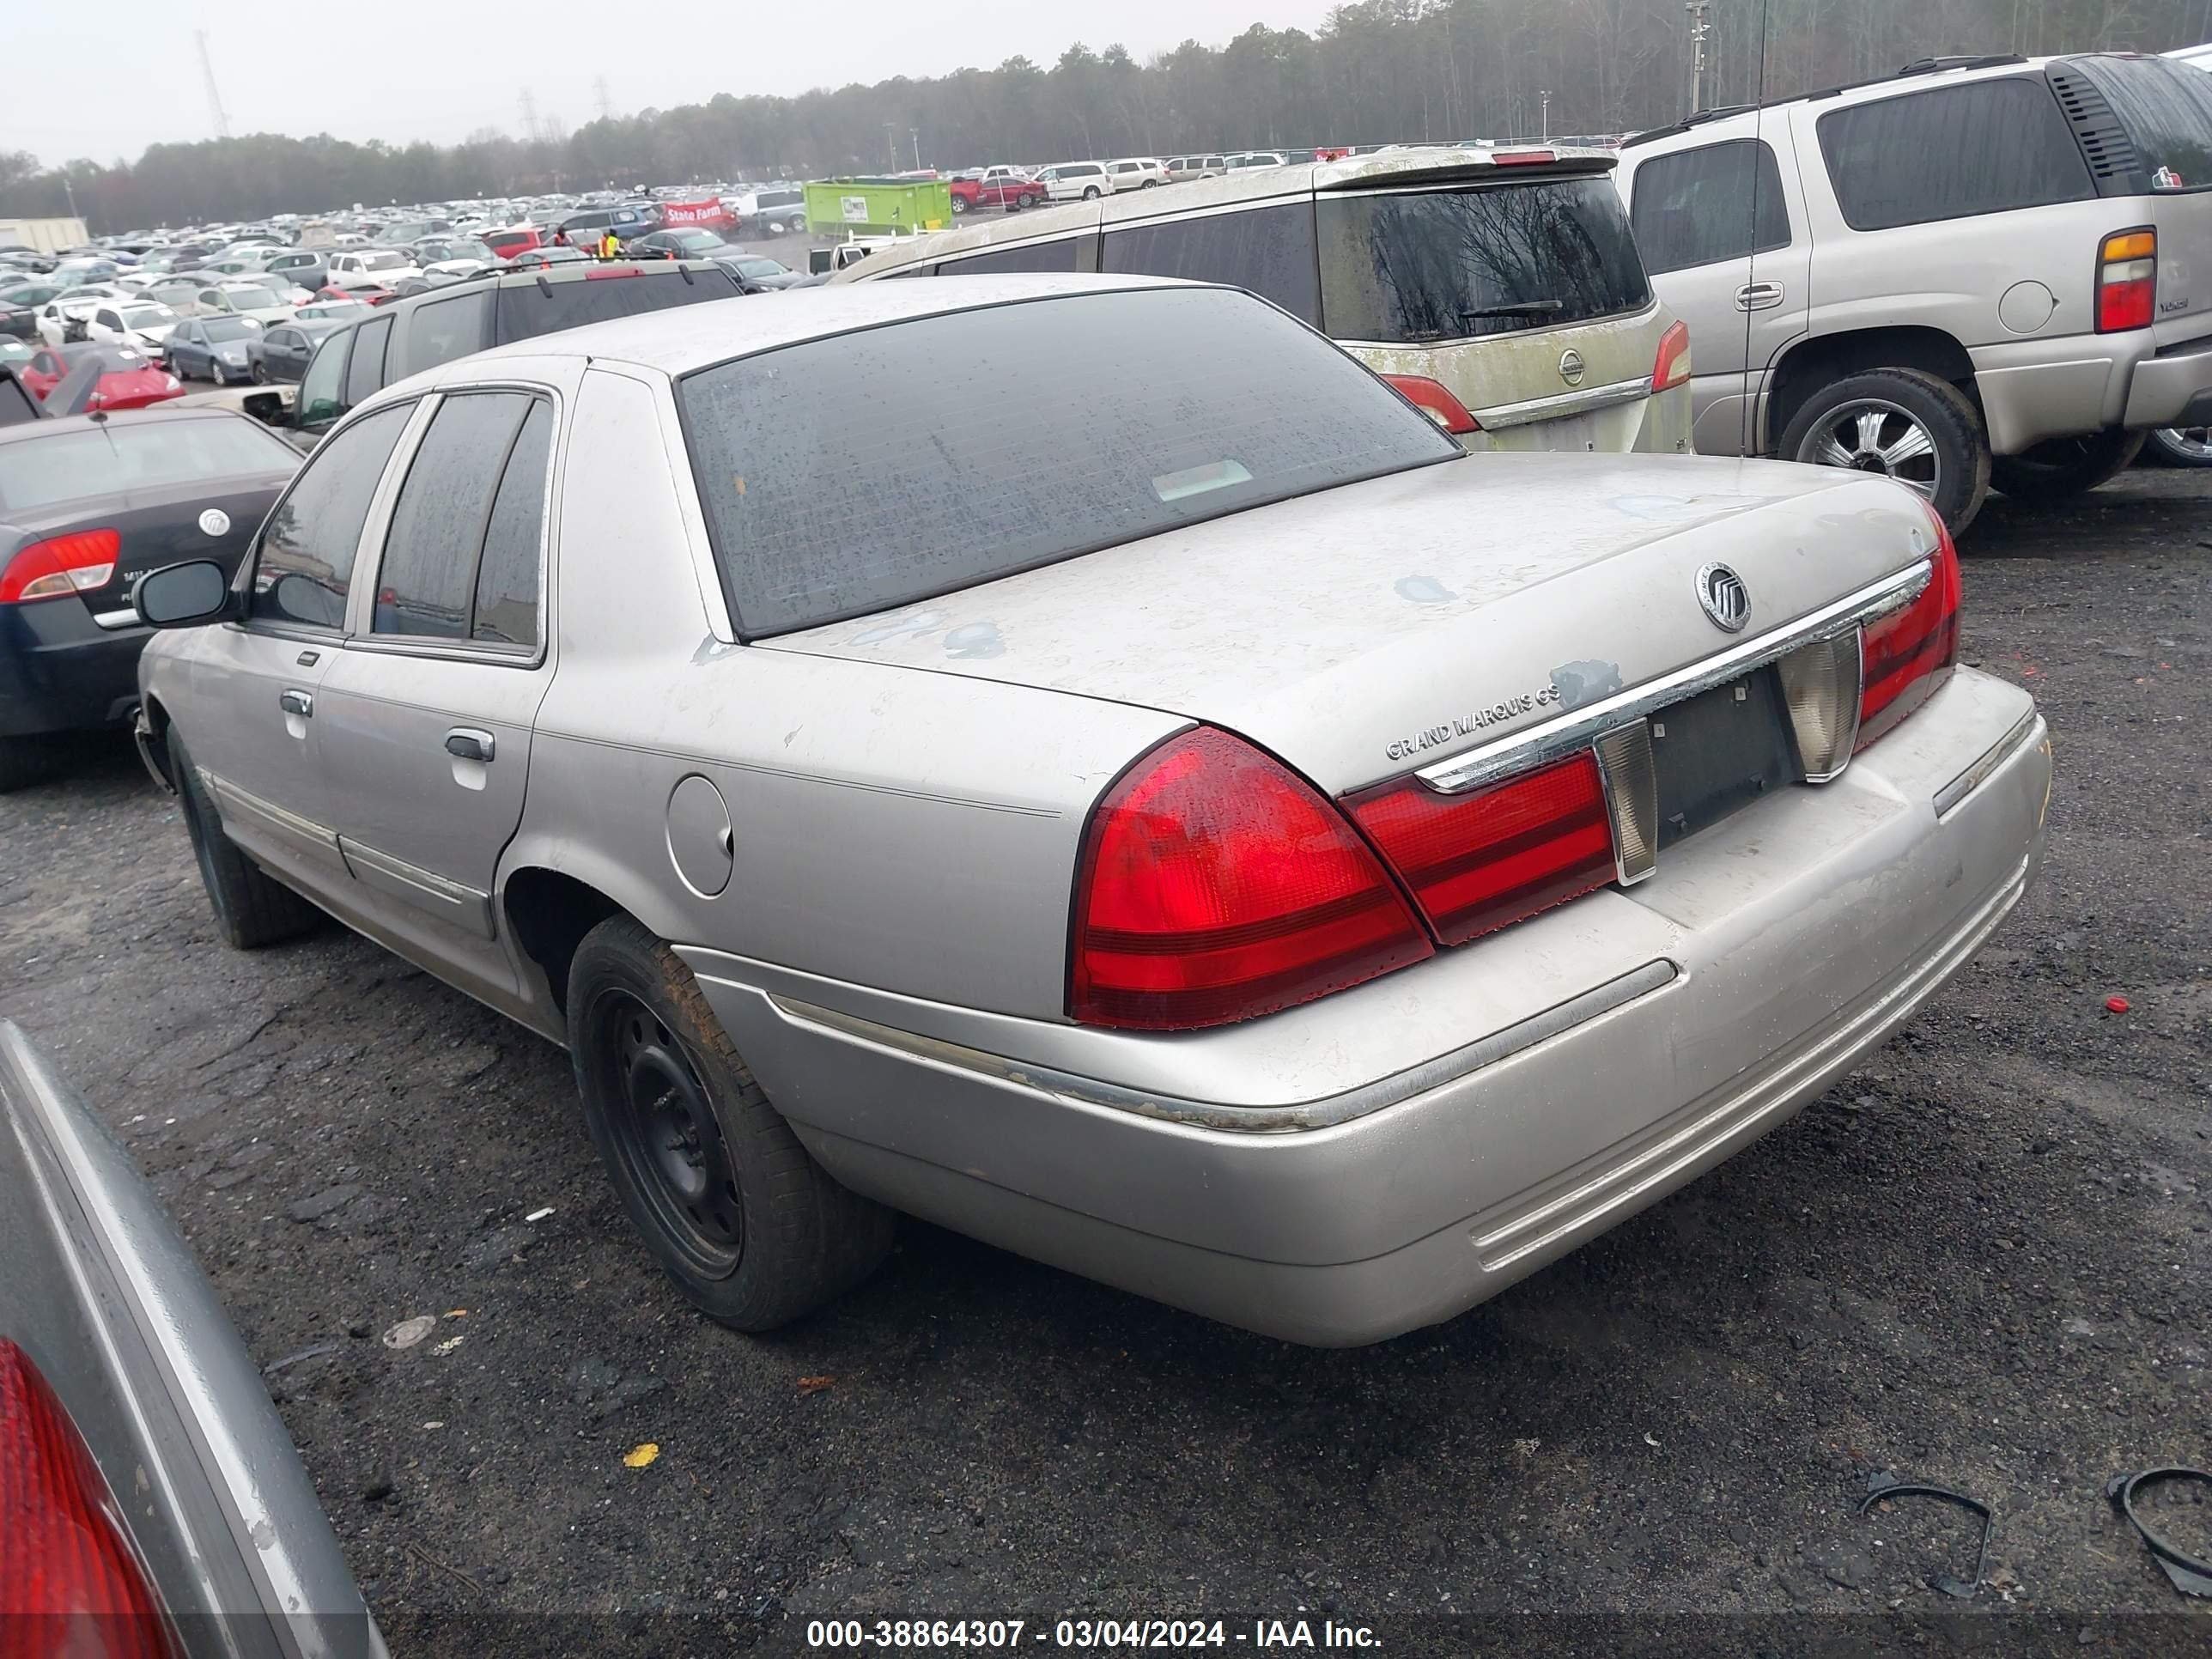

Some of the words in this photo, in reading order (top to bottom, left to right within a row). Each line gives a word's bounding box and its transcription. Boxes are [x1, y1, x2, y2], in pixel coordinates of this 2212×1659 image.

[668, 209, 695, 222] State
[696, 206, 720, 220] Farm
[1386, 724, 1451, 760] GRAND
[1452, 693, 1533, 736] MARQUIS
[1535, 684, 1561, 705] GS
